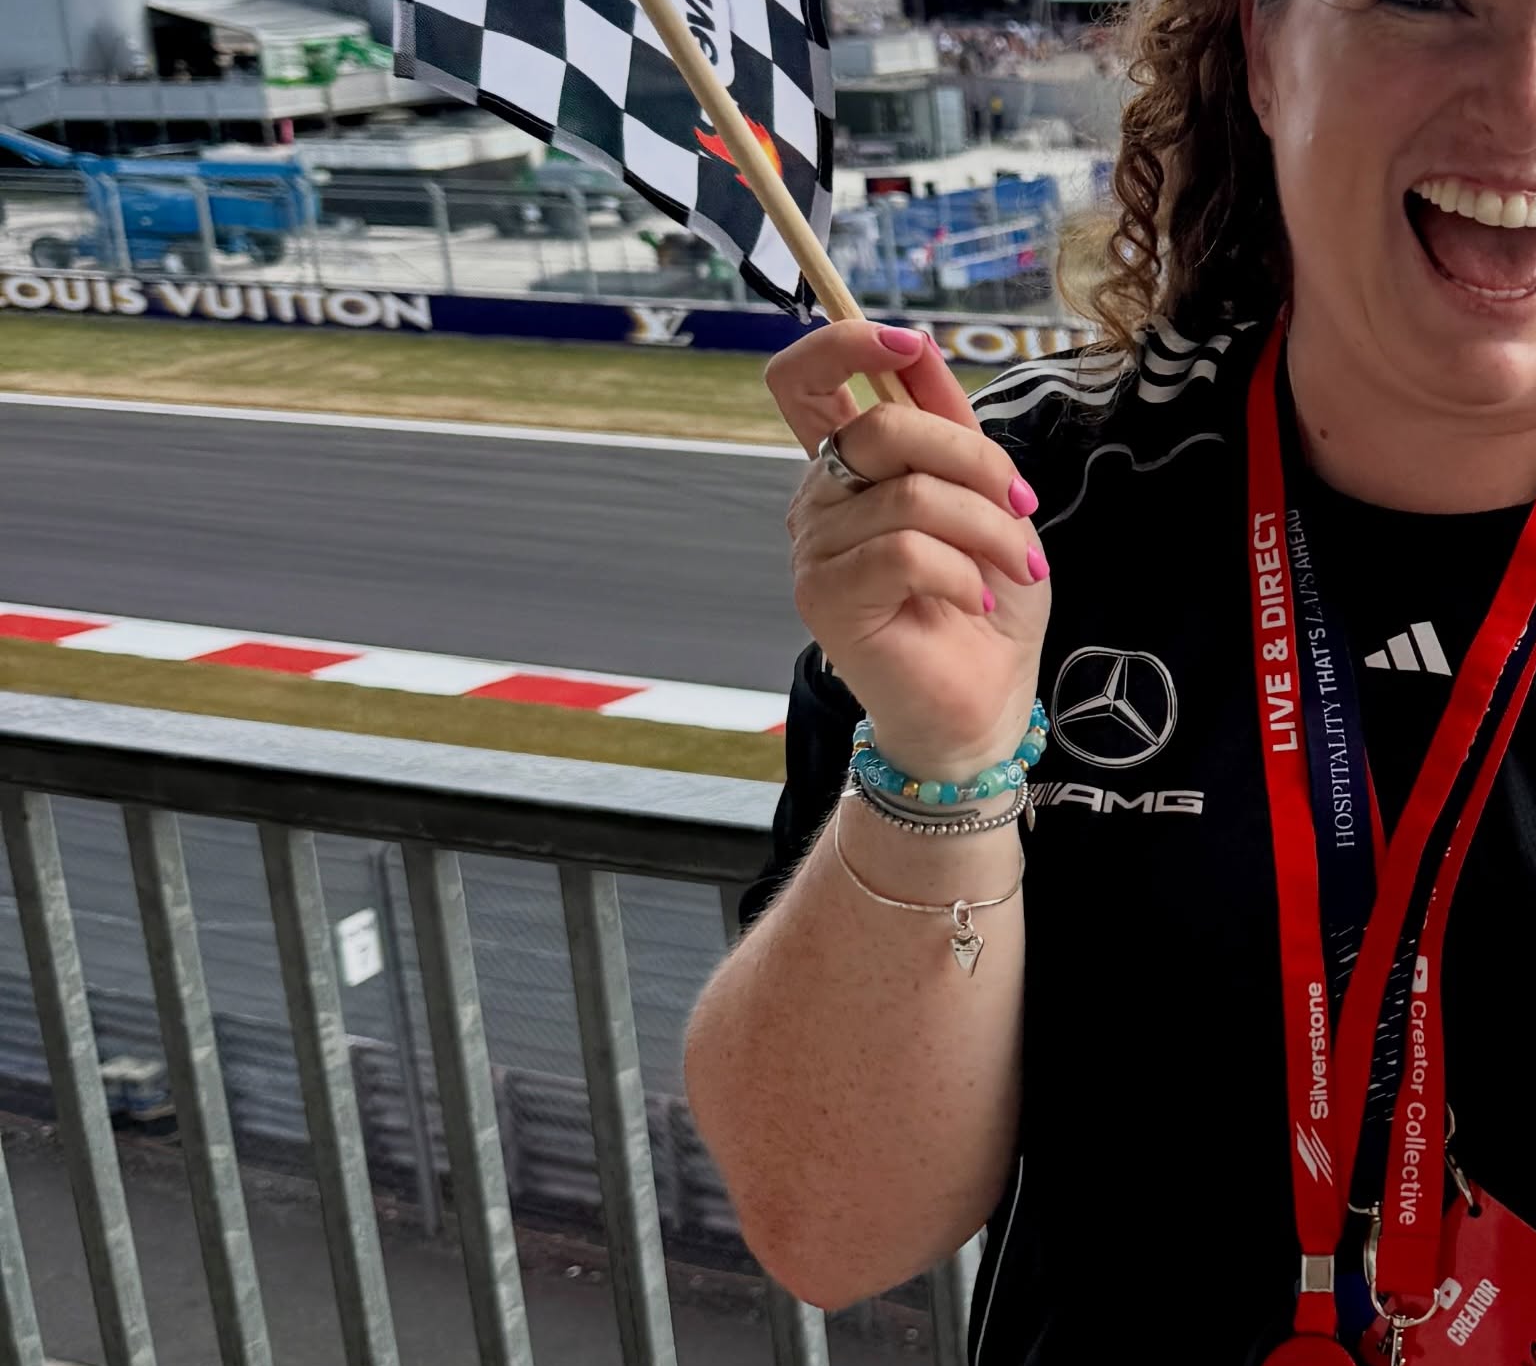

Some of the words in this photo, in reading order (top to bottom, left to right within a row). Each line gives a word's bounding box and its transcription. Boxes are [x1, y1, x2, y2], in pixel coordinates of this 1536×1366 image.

[158, 281, 432, 330] VUITTON
[1253, 512, 1288, 629] DIRECT
[1262, 636, 1289, 663] &
[1308, 627, 1337, 698] THAT'S
[1265, 672, 1298, 752] LIVE
[1051, 783, 1205, 815] AMG
[1323, 700, 1355, 848] HOSPITALITY
[1308, 981, 1329, 1120] Silverstone
[1410, 999, 1429, 1095] Creator
[1398, 1102, 1427, 1226] Collective
[1447, 1278, 1500, 1346] CREATOR
